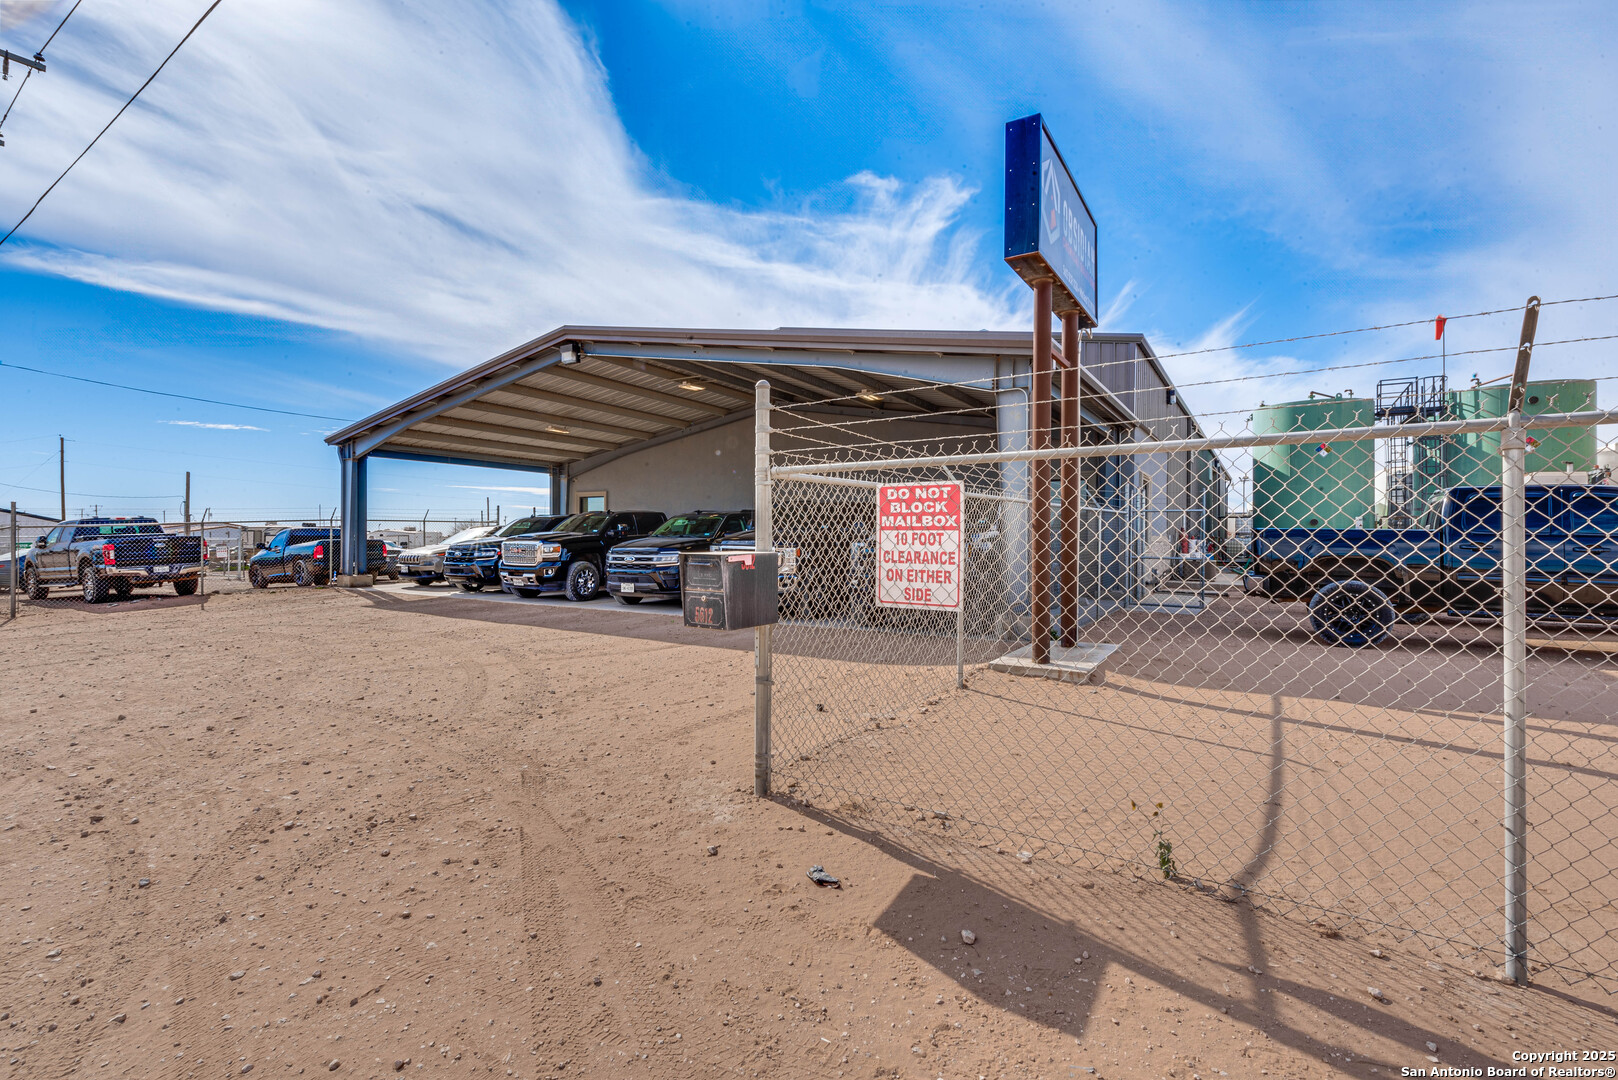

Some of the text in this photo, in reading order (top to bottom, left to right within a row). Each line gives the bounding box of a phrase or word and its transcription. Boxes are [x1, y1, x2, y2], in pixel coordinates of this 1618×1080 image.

[886, 486, 952, 500] DO NOT
[890, 501, 948, 513] BLOCK
[881, 515, 958, 527] MAILBOX
[894, 532, 944, 546] 10 FOOT
[883, 550, 956, 565] CLEARANCE
[886, 568, 952, 584] ON EITHER
[904, 587, 932, 602] SIDE
[694, 606, 714, 624] 5612
